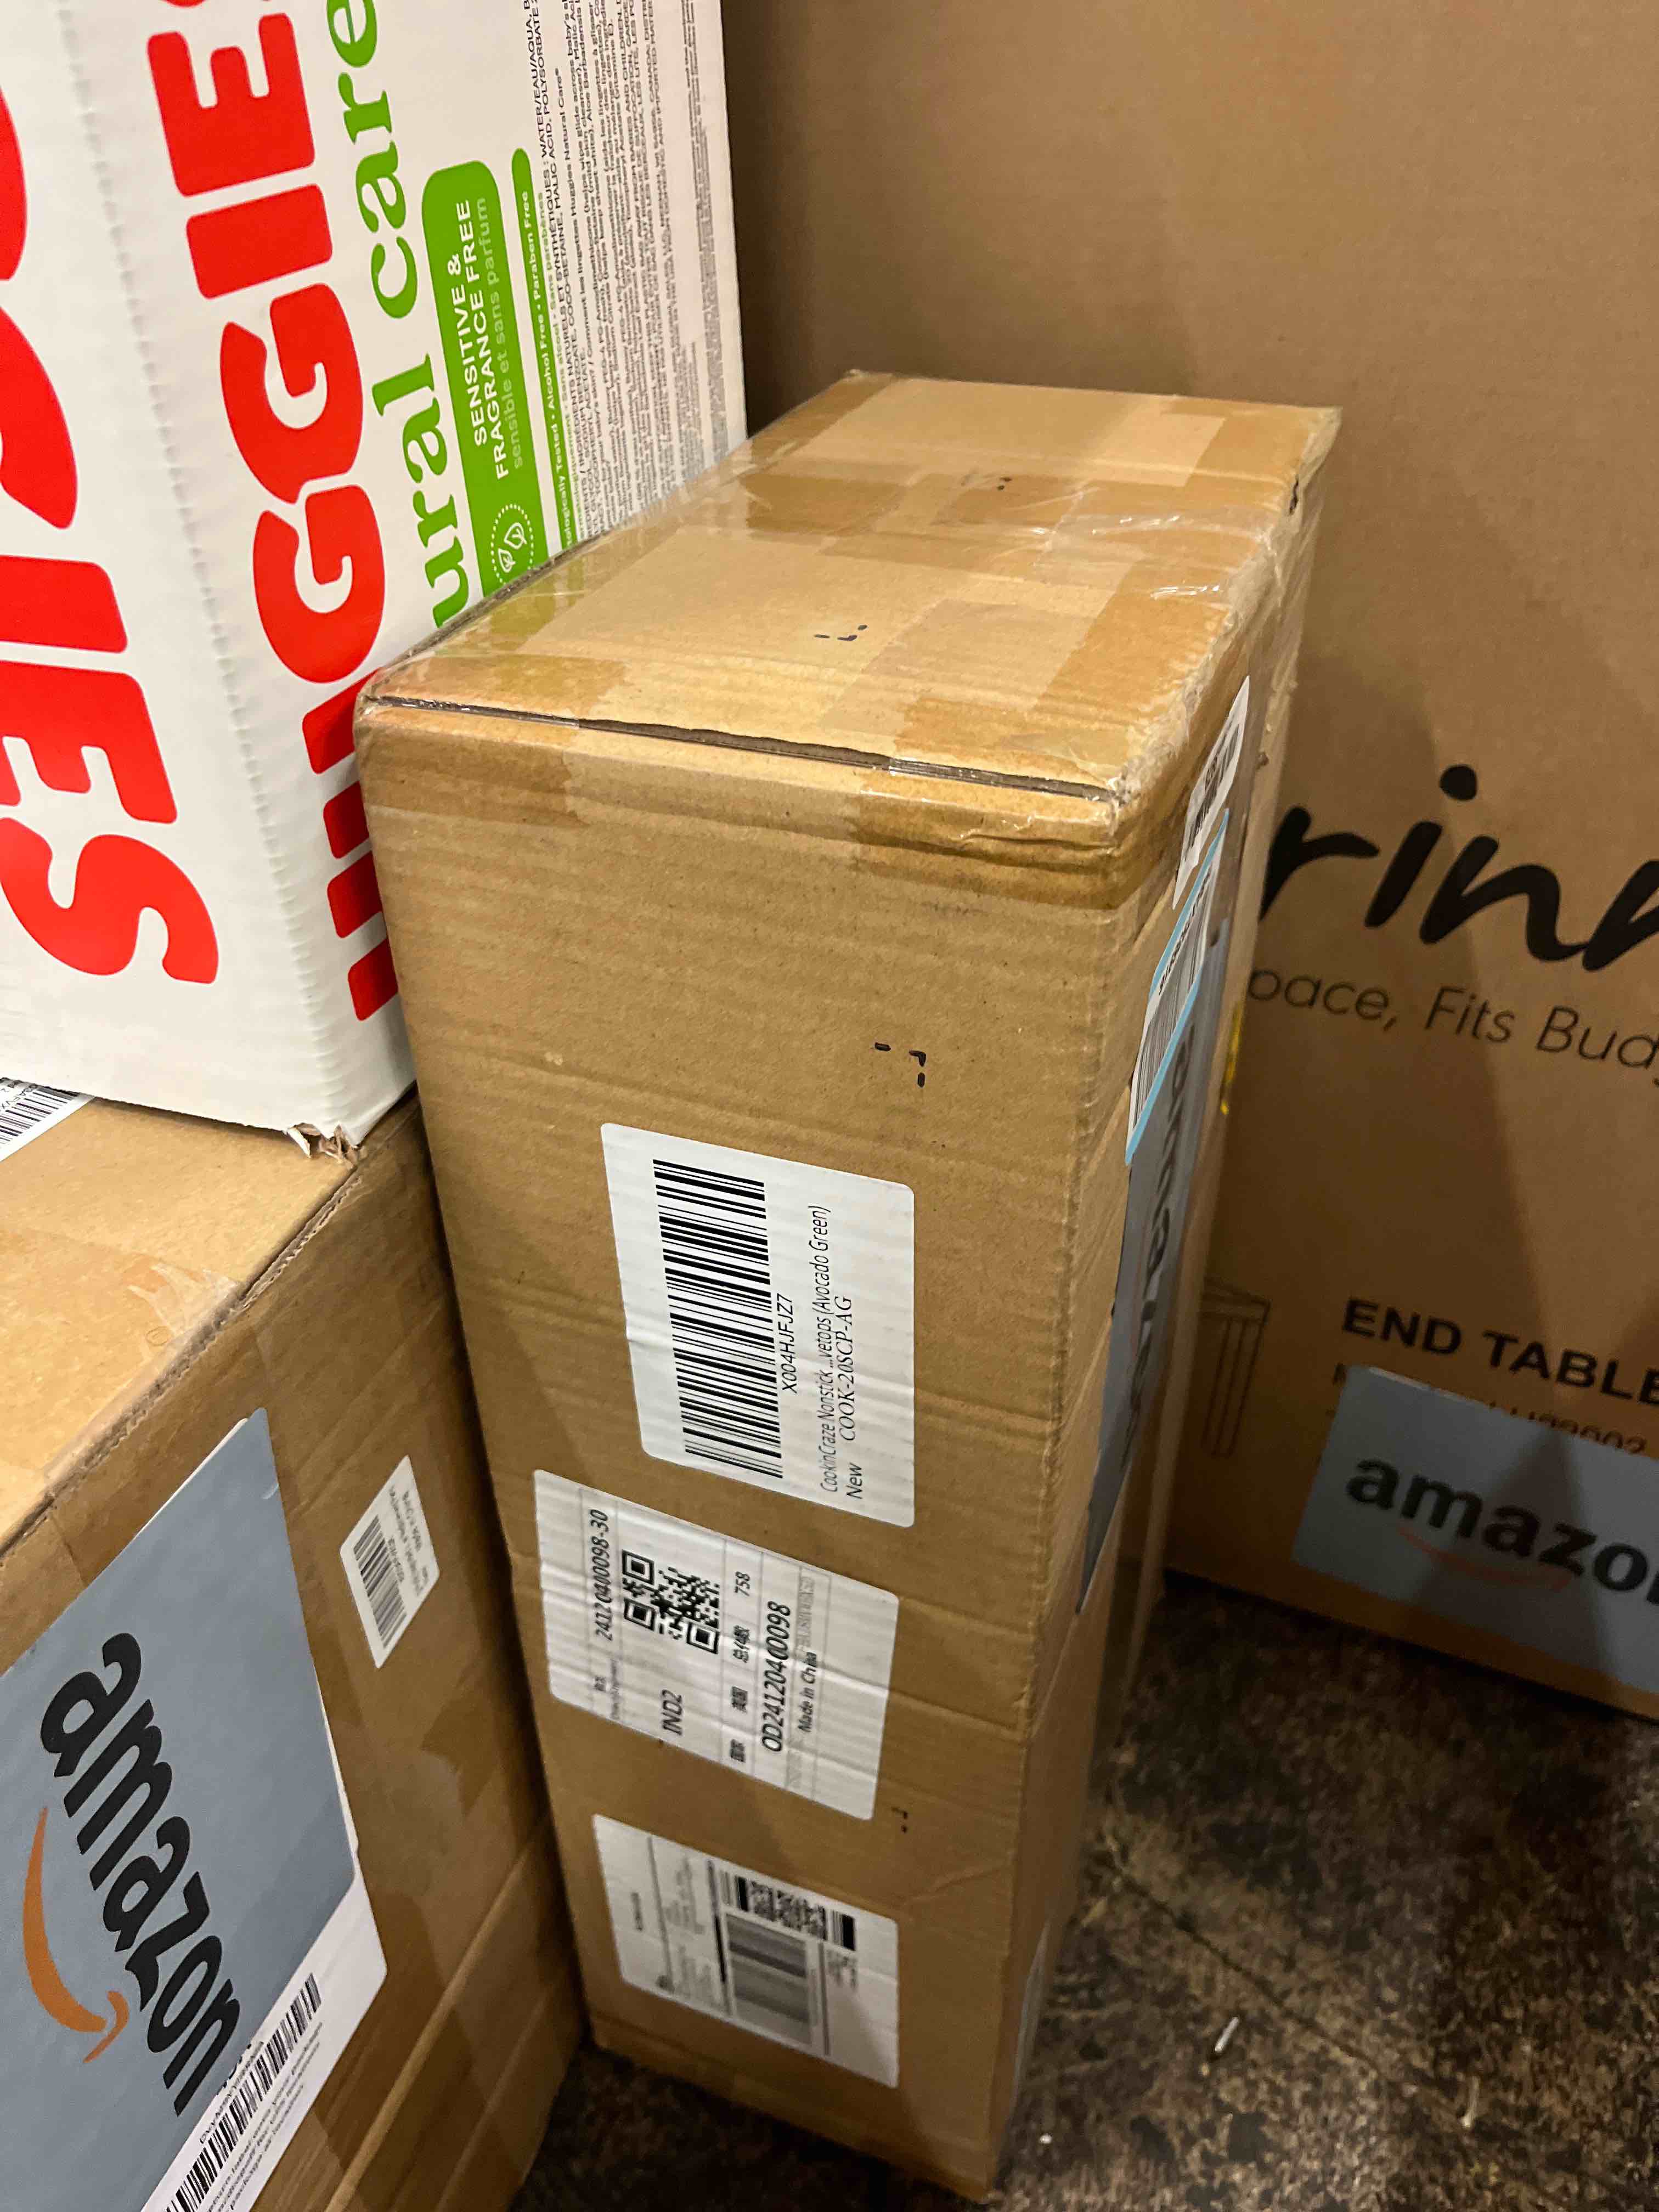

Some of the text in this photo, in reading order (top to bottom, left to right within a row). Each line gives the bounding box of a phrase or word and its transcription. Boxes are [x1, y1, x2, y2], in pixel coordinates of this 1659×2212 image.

[525, 13, 547, 157] WATER/EAU/AQUA,
[533, 7, 550, 114] POLYSORBATE
[329, 0, 417, 319] care
[560, 111, 571, 160] Natural
[518, 190, 533, 229] Free
[551, 162, 560, 208] MALIC
[544, 169, 562, 281] SYNTHÉTIQUES
[524, 233, 541, 300] Paraben
[445, 253, 488, 445] SENSITIVE &
[456, 200, 510, 479] FRAGRANCE FREE
[474, 197, 525, 468] sensible et sans parfum
[535, 314, 548, 348] Free
[540, 352, 555, 408] Alcohol
[550, 424, 563, 471] Tested
[1426, 986, 1516, 1045] Fits
[1536, 1005, 1659, 1089] Bud
[807, 1205, 832, 1251] Green)
[809, 1255, 834, 1313] (Avocado
[776, 1293, 799, 1393] X004HJFJZ7
[1342, 1299, 1659, 1406] END TABLE
[814, 1370, 836, 1419] Nonstick
[833, 1295, 864, 1499] New COOK-20SCP-AG
[818, 1424, 838, 1492] CookinCraze
[1345, 1457, 1659, 1606] amazo
[734, 1571, 751, 1596] 758
[661, 1689, 682, 1736] IND2
[796, 1701, 814, 1732] Made
[800, 1687, 814, 1699] in
[41, 1633, 240, 2117] amazon
